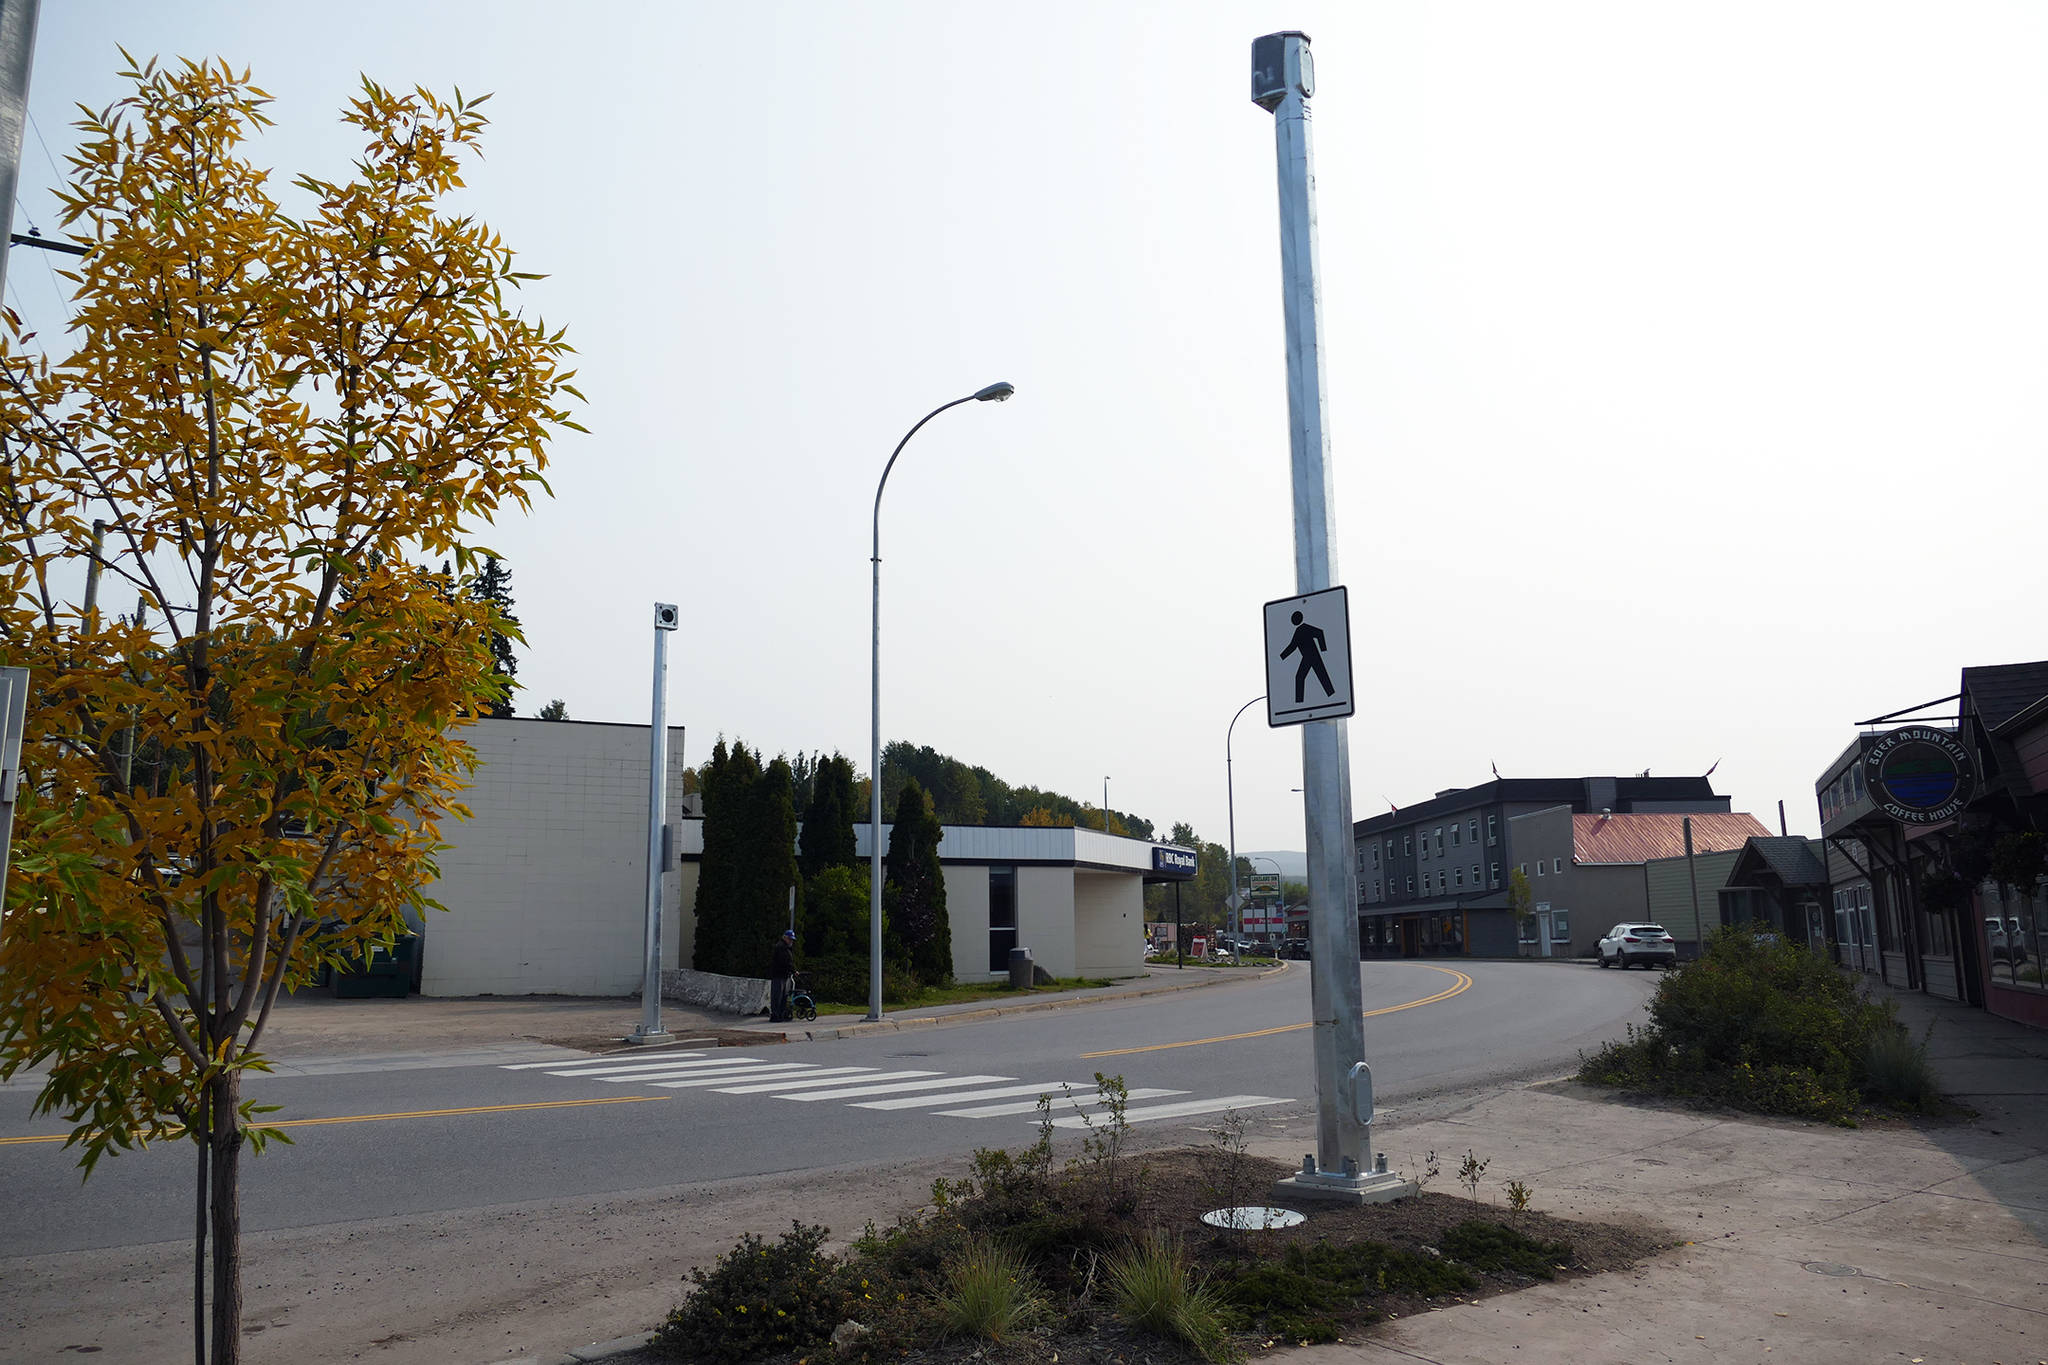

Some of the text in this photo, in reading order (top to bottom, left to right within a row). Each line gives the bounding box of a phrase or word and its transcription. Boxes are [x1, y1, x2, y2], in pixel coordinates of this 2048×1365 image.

[1868, 730, 1967, 766] BOER MOUNTAIN
[1883, 798, 1963, 822] COFFEE HOUSE
[1165, 852, 1195, 868] RBC Royal Bank
